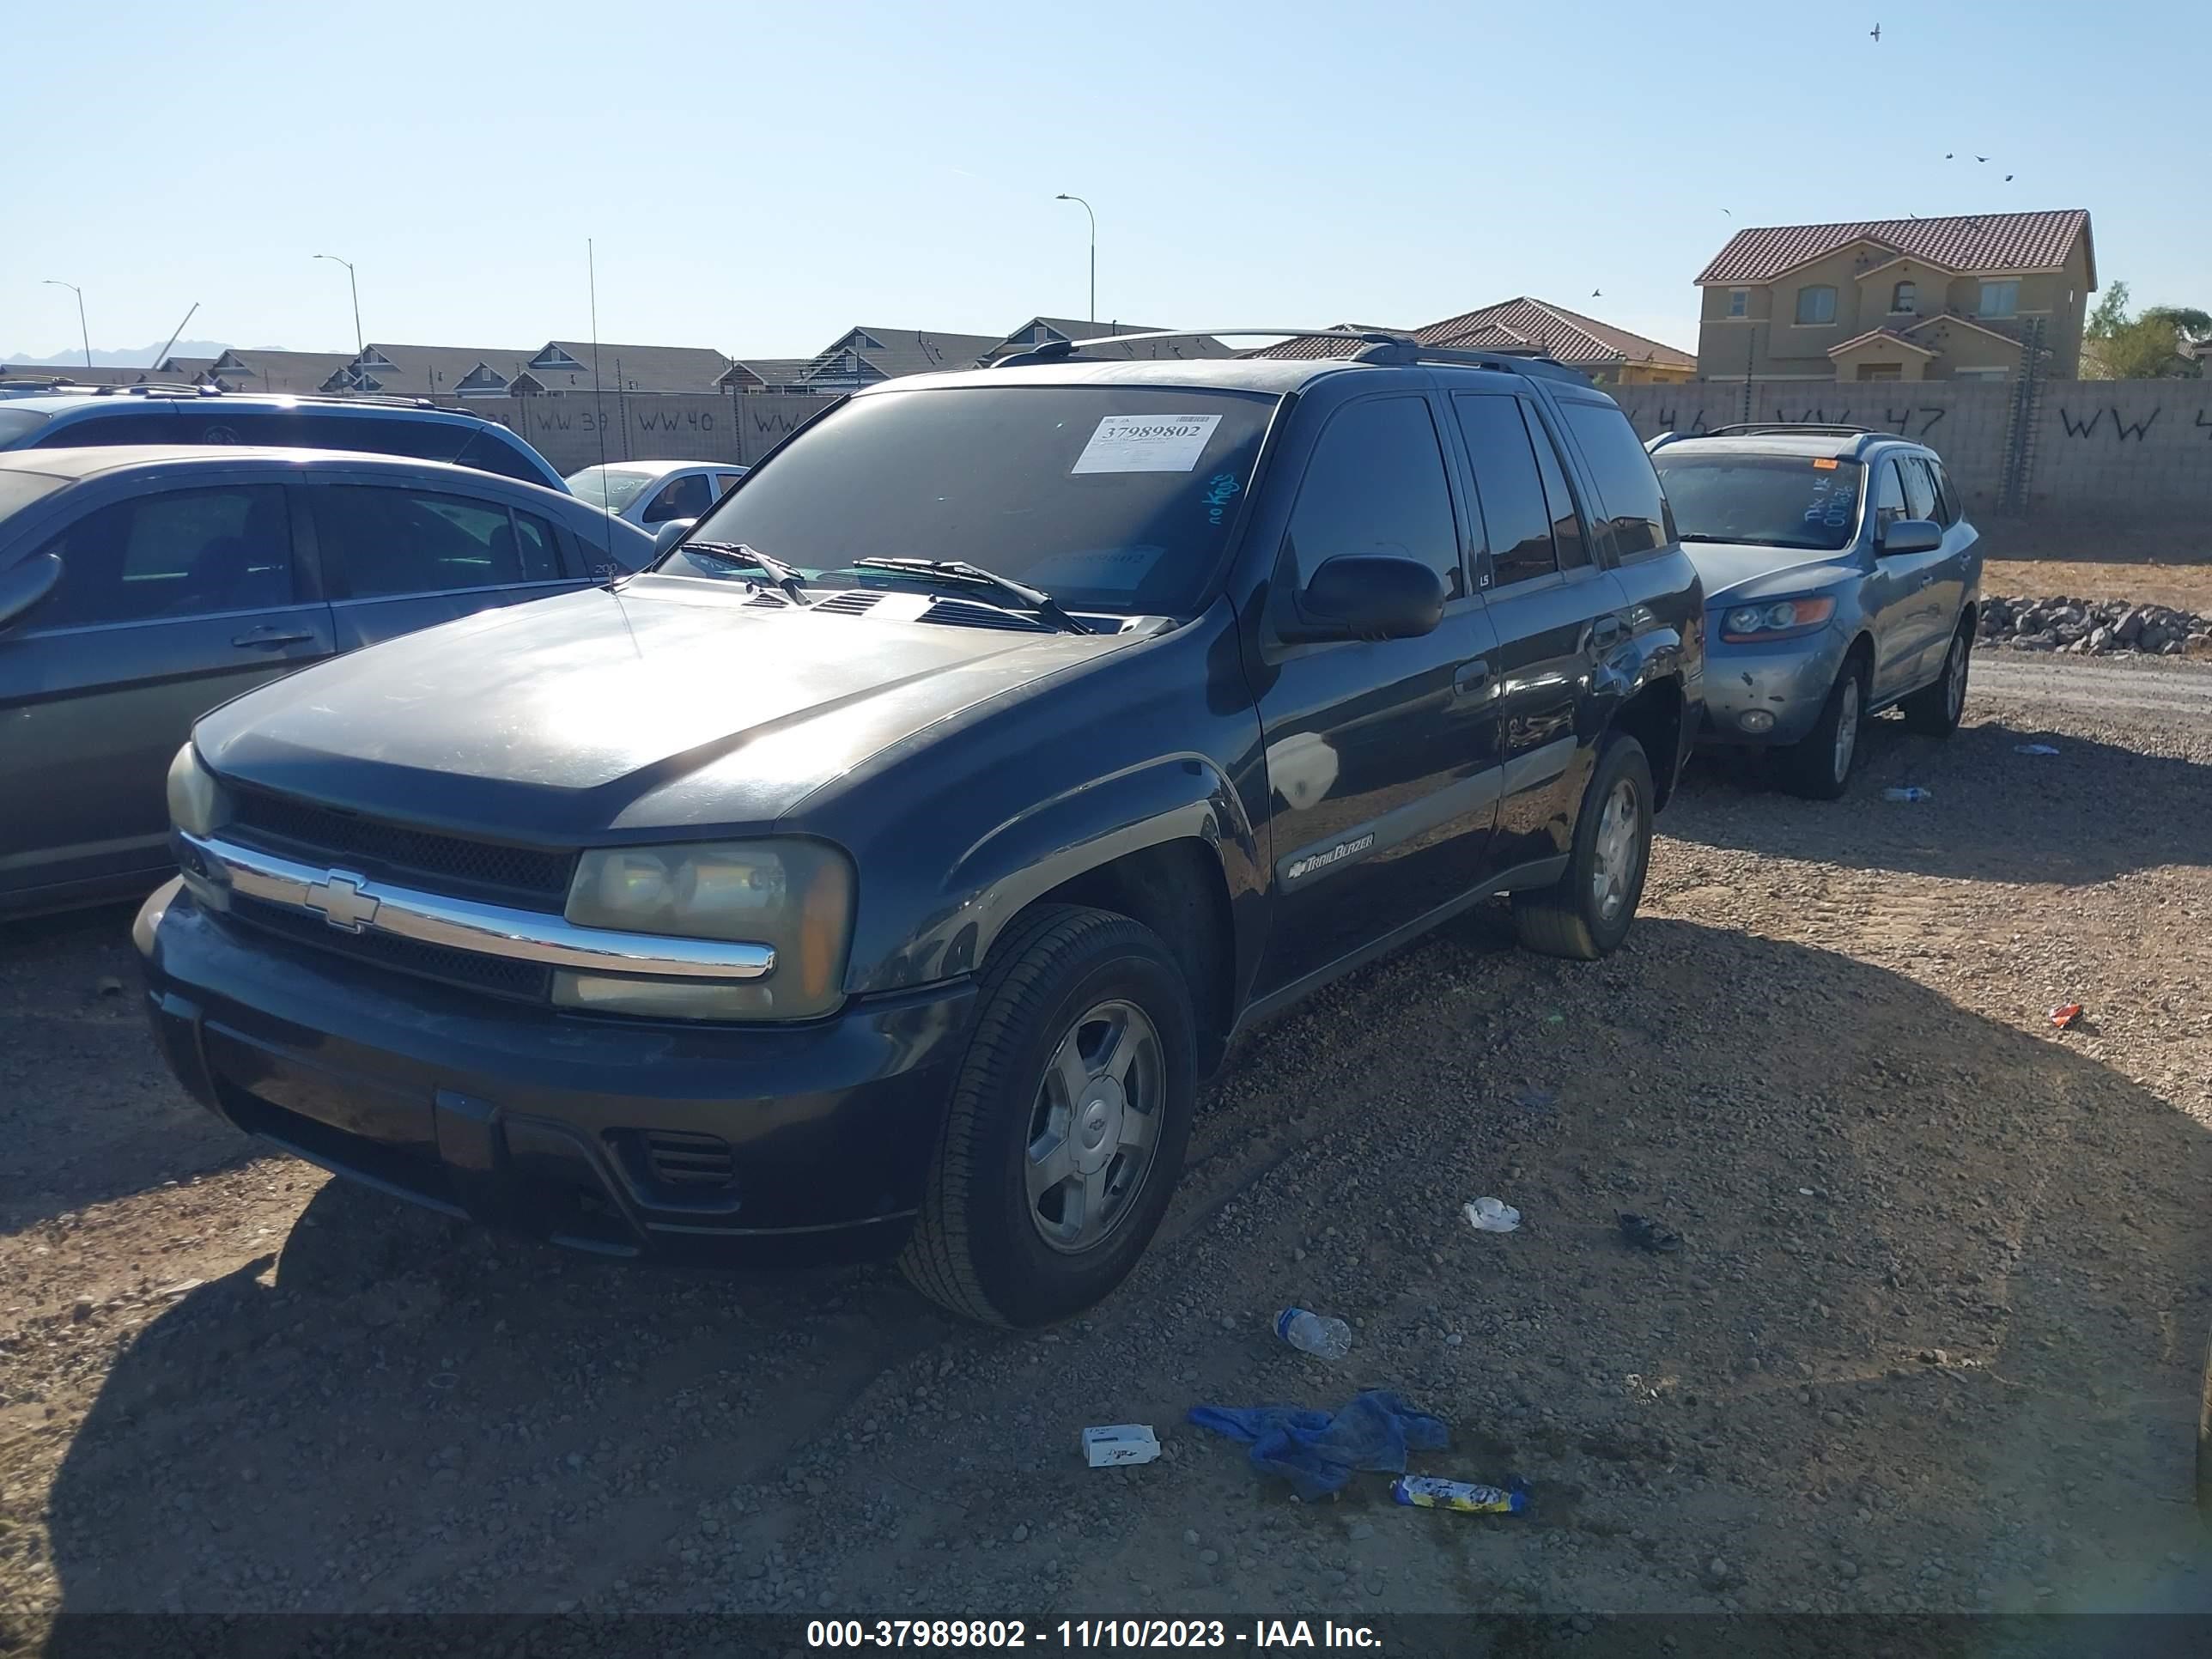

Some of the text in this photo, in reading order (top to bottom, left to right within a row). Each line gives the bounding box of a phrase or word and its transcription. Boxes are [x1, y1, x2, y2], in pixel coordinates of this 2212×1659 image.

[537, 412, 608, 432] WW 39
[638, 412, 714, 431] WW 40
[754, 412, 799, 432] WW
[1659, 408, 1708, 433] 46
[1887, 408, 1946, 436] 47
[2061, 407, 2161, 441] WW
[1103, 426, 1200, 439] 37989802
[594, 562, 618, 574] 200
[1480, 574, 1489, 587] LS
